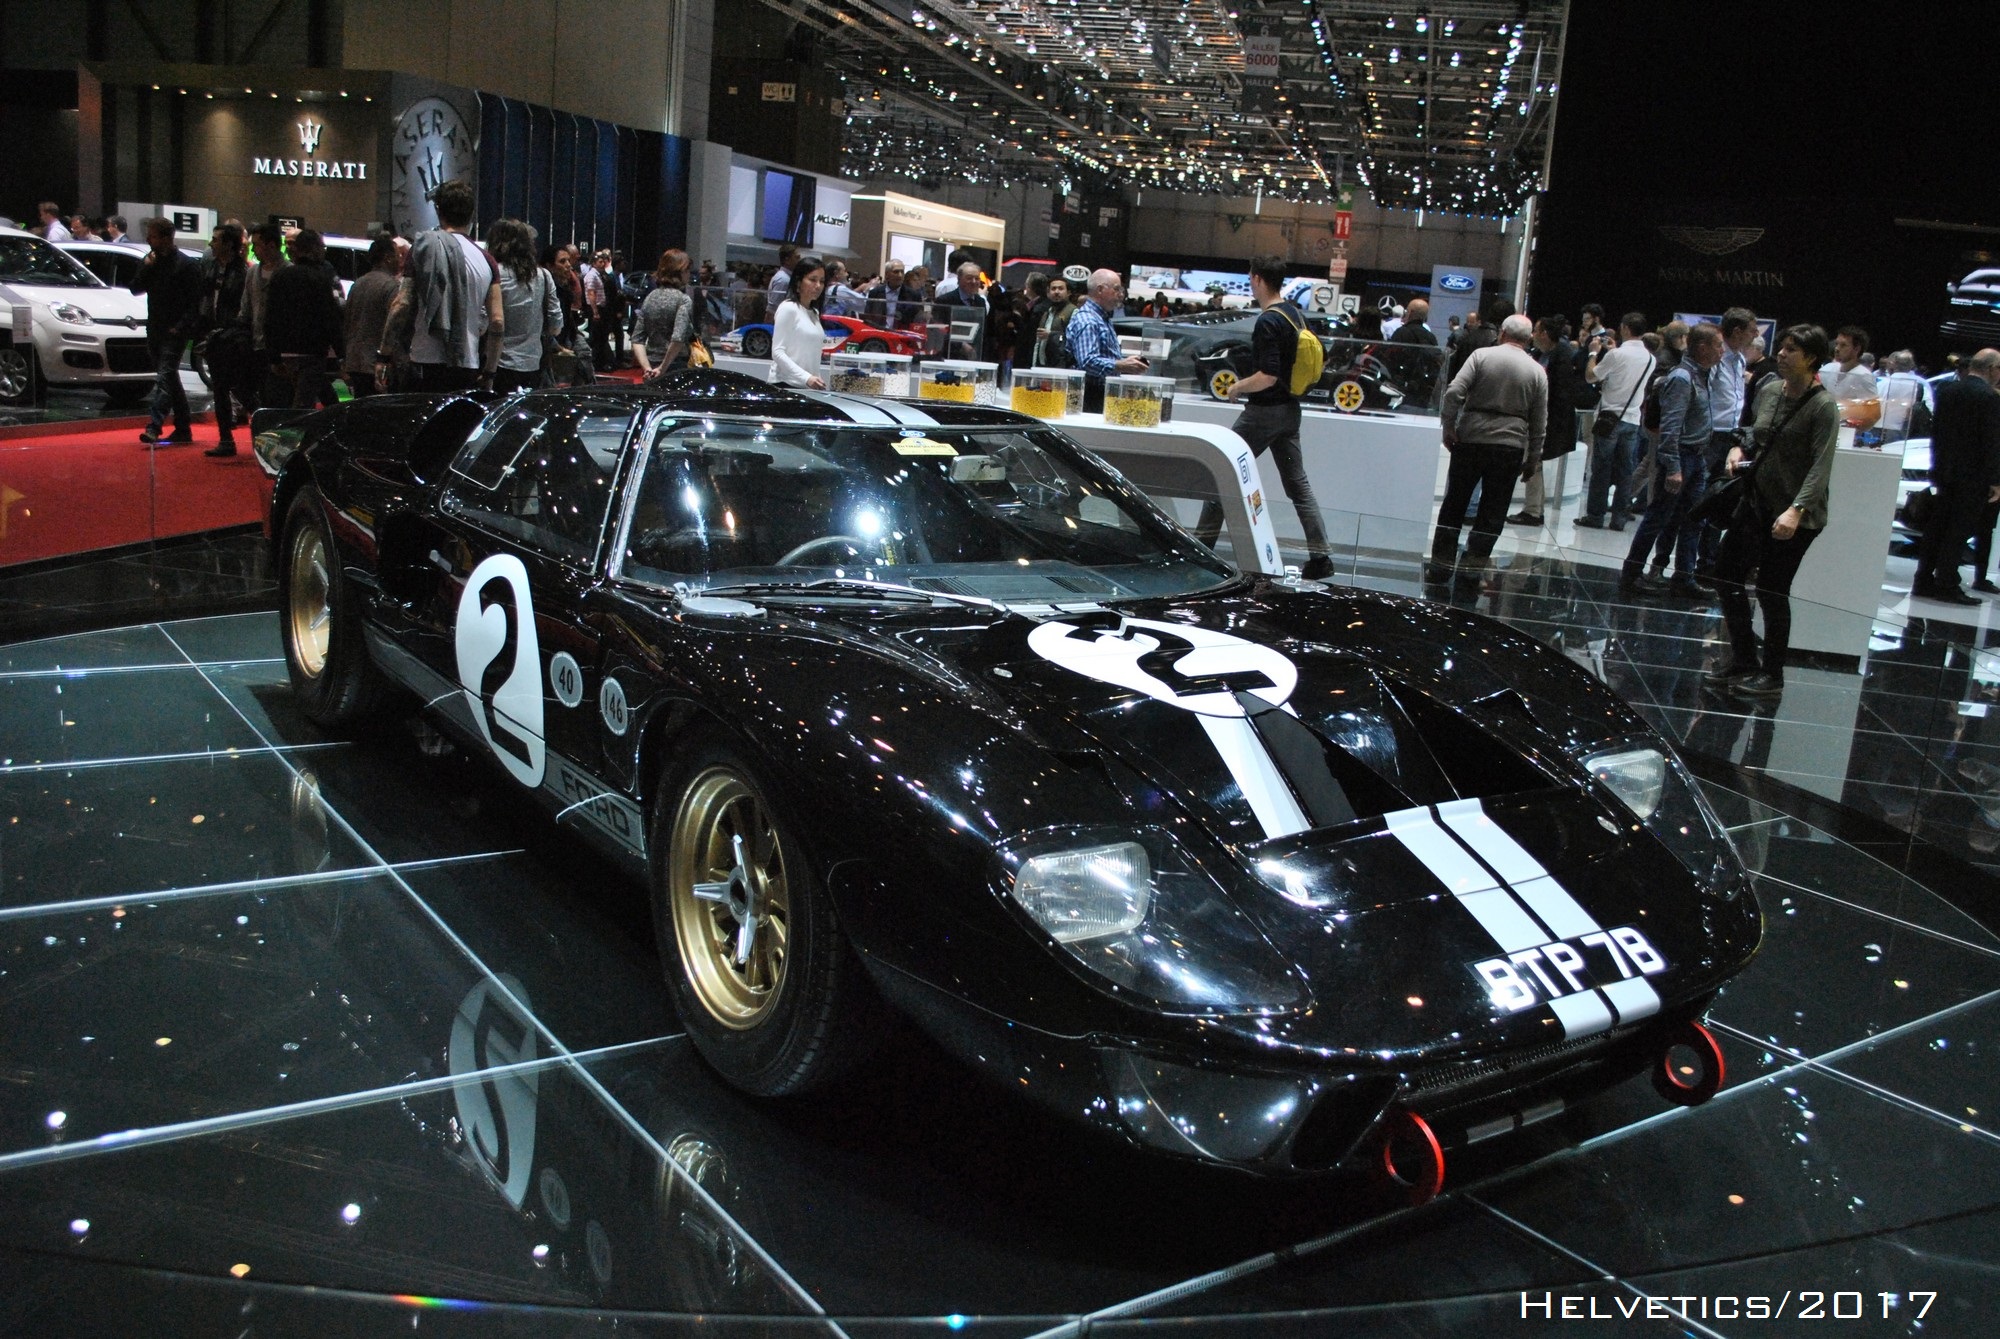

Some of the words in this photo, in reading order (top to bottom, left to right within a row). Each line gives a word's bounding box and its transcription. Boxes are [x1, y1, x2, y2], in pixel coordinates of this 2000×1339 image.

[1246, 53, 1278, 66] 6000
[254, 157, 367, 180] MASERATI
[1716, 270, 1784, 287] MARTIN
[478, 575, 534, 770] 2
[1065, 624, 1278, 698] 2
[559, 665, 574, 694] 40
[605, 689, 623, 724] 146
[561, 768, 631, 838] FORD
[1474, 941, 1585, 1013] BTP
[1579, 926, 1667, 979] 7B
